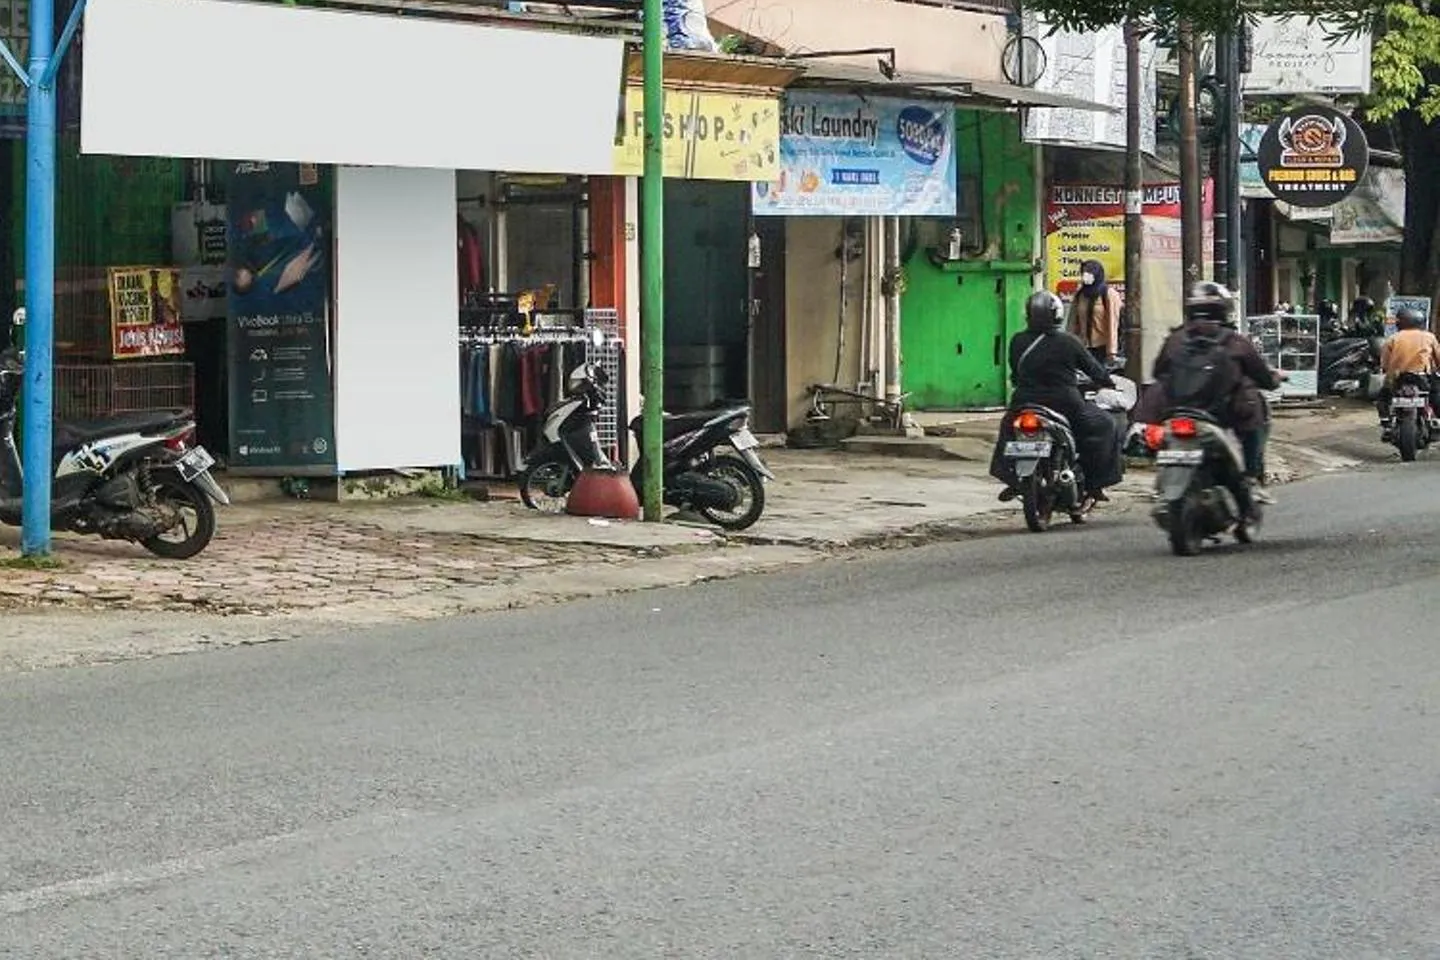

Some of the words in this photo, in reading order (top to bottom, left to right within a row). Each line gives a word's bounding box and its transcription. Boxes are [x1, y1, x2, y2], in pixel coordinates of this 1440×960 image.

[663, 113, 725, 141] SHOP
[811, 106, 879, 146] Laundry
[1054, 186, 1122, 205] KONNECT
[1278, 183, 1346, 191] TREATMENT
